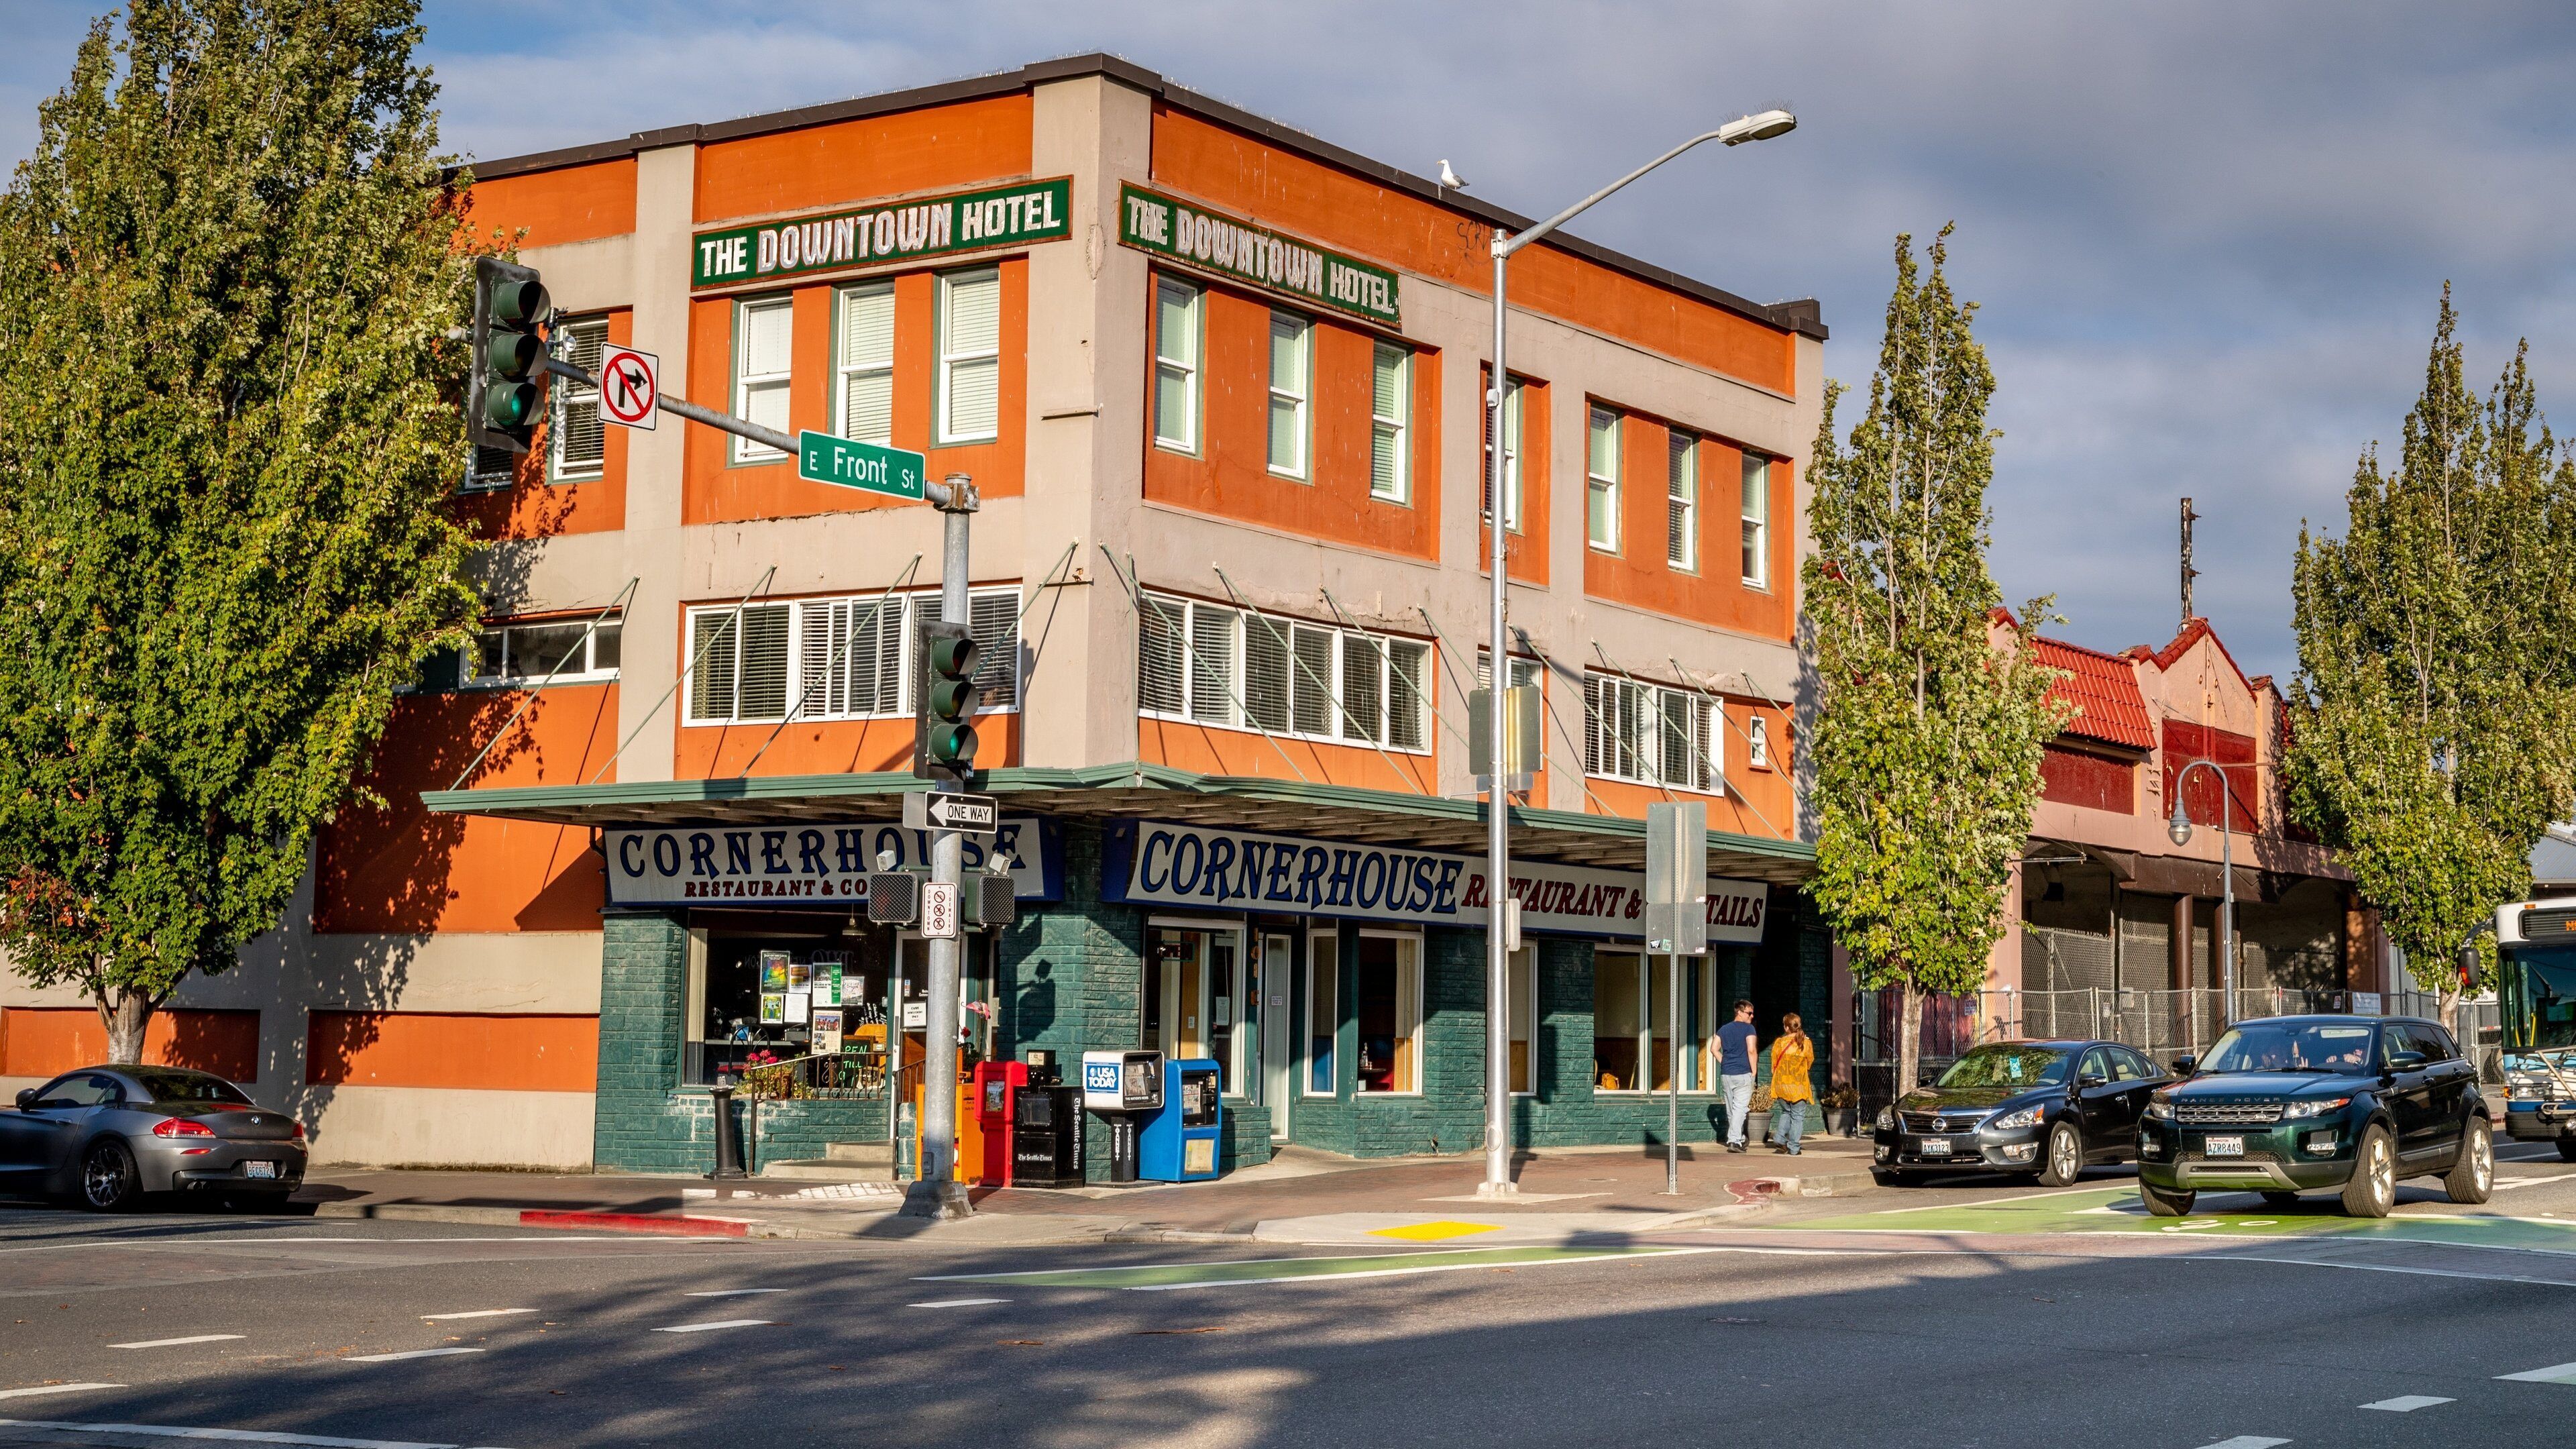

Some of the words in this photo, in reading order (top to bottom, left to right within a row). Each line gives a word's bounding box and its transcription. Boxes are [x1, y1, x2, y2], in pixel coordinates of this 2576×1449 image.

[700, 236, 748, 277] THE
[757, 203, 953, 274] DOWNTOWN
[961, 191, 1061, 241] HOTEL
[1127, 195, 1168, 245] THE
[1175, 207, 1324, 296] DOWNTOWN
[1330, 262, 1395, 315] HOTEL
[810, 450, 818, 471] E
[834, 446, 888, 484] Front
[902, 468, 914, 490] St
[948, 805, 967, 818] ONE
[970, 807, 989, 821] WAY
[1140, 830, 1464, 914] CORNERHOUSE
[684, 879, 816, 898] RESTAURANT
[821, 879, 834, 896] &
[1461, 874, 1625, 918] RTAURANT
[1625, 890, 1642, 920] &
[1706, 895, 1764, 928] TAILS
[845, 1045, 867, 1055] PEN
[1097, 1067, 1116, 1077] USA
[1088, 1077, 1117, 1087] TODAY
[1924, 1144, 1949, 1152] AYK3123
[2208, 1143, 2241, 1153] AZR8449
